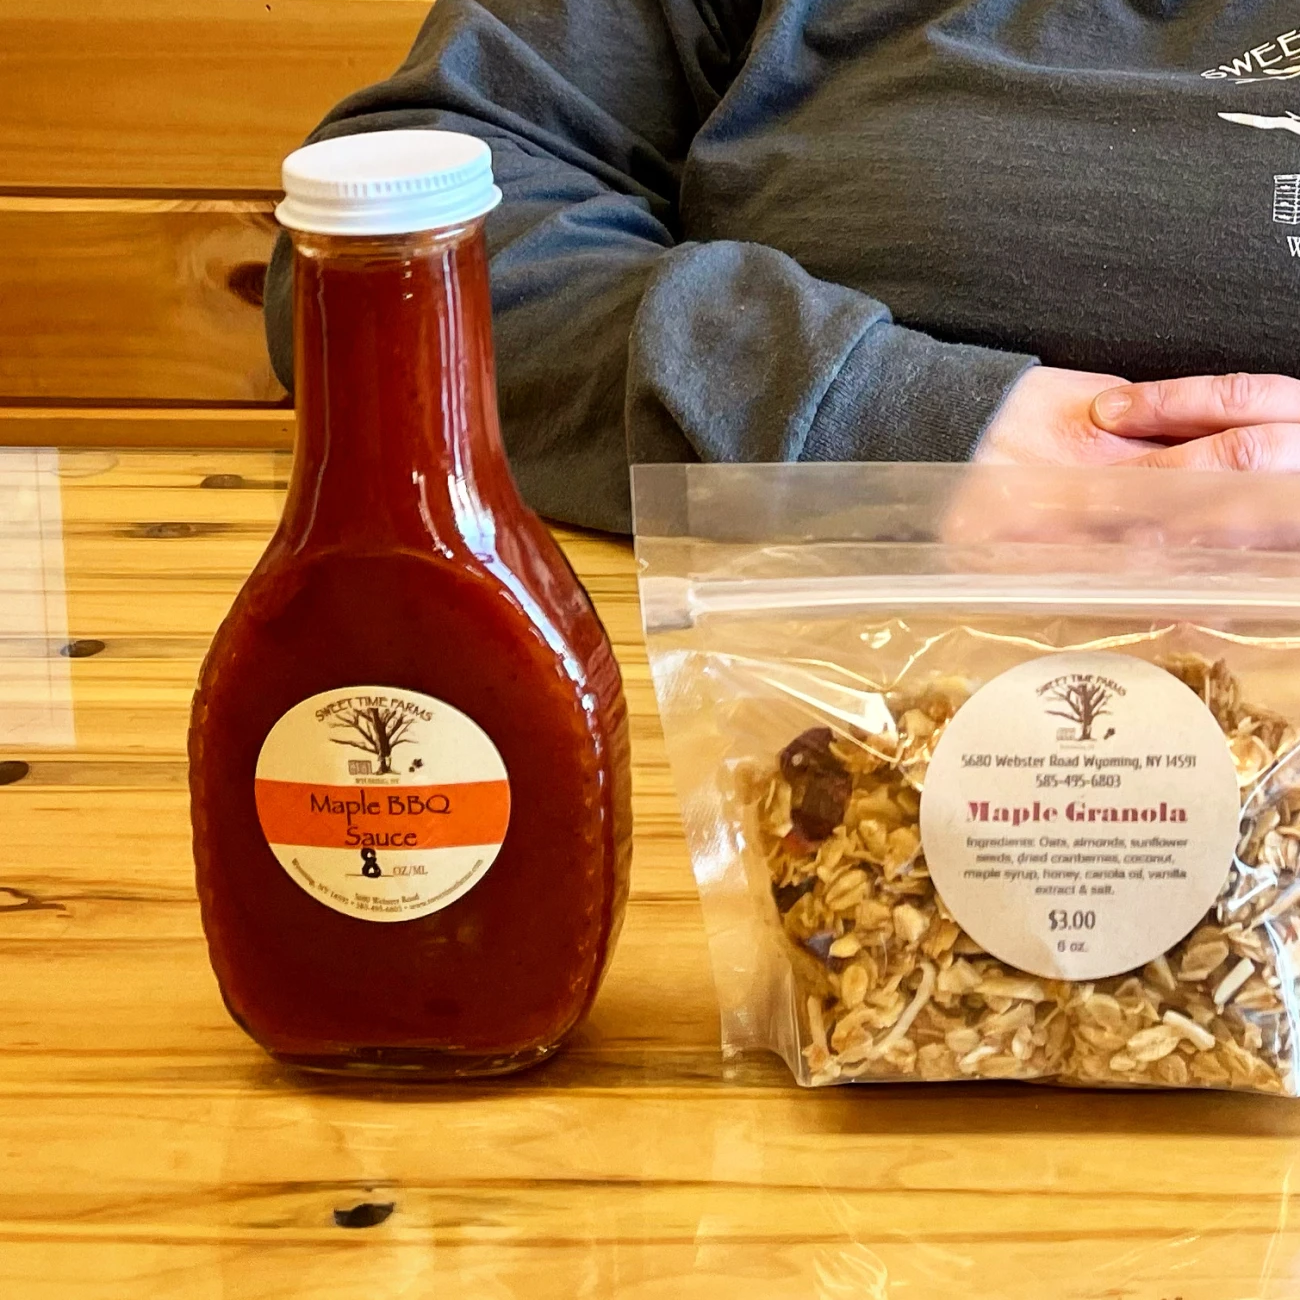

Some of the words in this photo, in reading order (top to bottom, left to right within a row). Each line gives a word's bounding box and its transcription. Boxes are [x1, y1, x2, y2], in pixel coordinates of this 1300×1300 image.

[314, 697, 353, 722] SWEET
[355, 696, 388, 707] TIME
[390, 698, 434, 722] FARMS
[961, 754, 991, 768] 5680
[995, 754, 1045, 767] Webster
[1050, 754, 1079, 767] Road
[1084, 755, 1142, 770] Wyoming,
[1146, 755, 1161, 767] NY
[1166, 755, 1197, 767] 14591
[1036, 774, 1121, 788] 585-495-6803
[310, 790, 380, 825] Maple
[388, 794, 452, 815] BBQ
[967, 801, 1058, 826] Maple
[1065, 801, 1188, 823] Granola
[345, 827, 417, 847] Sauce
[1039, 837, 1069, 849] Oats,
[1073, 837, 1127, 849] almonds,
[1130, 837, 1188, 848] sunflower
[360, 848, 382, 878] 8
[976, 853, 1014, 864] seeds,
[1017, 852, 1048, 864] dried
[1051, 852, 1120, 865] cranberries,
[1123, 853, 1175, 865] coconut,
[392, 865, 428, 877] OZ/ML
[964, 869, 1001, 880] maple
[1004, 869, 1039, 881] syrup,
[1085, 869, 1125, 879] canola
[1148, 868, 1187, 879] vanilla
[1035, 885, 1076, 895] extract
[1078, 885, 1088, 895] &
[1048, 909, 1096, 931] $3.00
